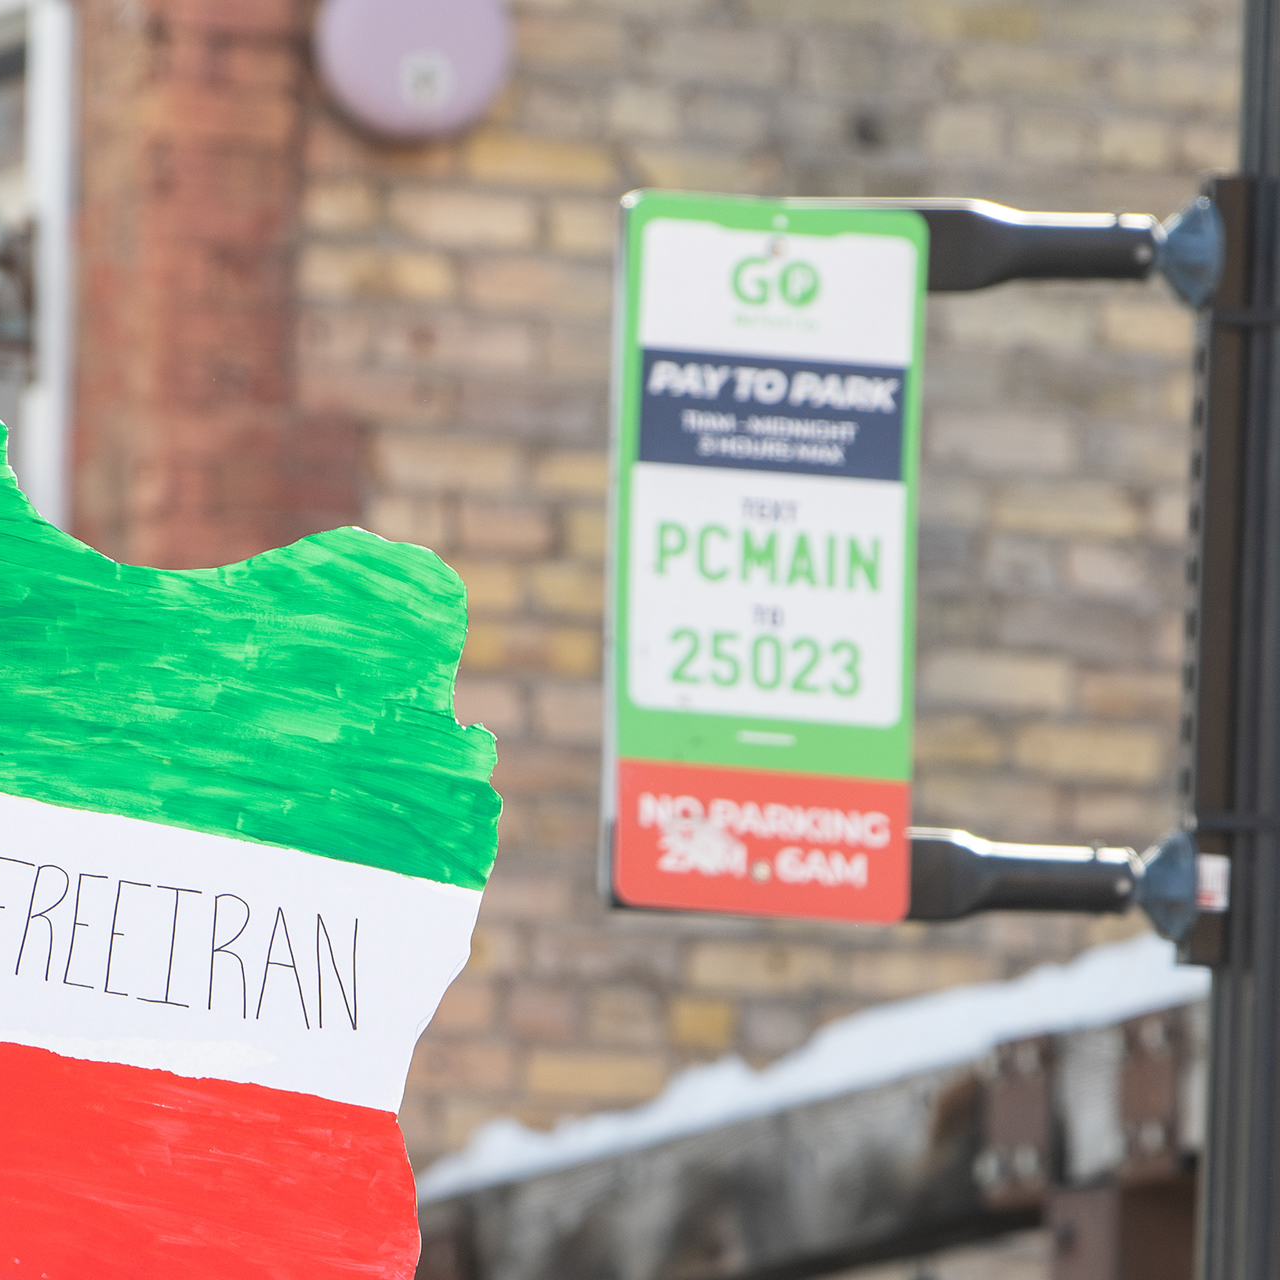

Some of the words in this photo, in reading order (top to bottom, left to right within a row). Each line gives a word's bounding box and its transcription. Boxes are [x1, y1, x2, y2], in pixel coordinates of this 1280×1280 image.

[648, 360, 732, 400] PAY
[731, 365, 789, 405] TO
[789, 371, 901, 413] PARK
[747, 414, 860, 444] MIDNIGHT
[796, 443, 847, 466] MAX
[655, 522, 882, 592] PCMAIN
[669, 626, 860, 698] 25023
[637, 792, 706, 830] NO
[707, 798, 891, 850] PARKING
[775, 846, 868, 888] 6AM
